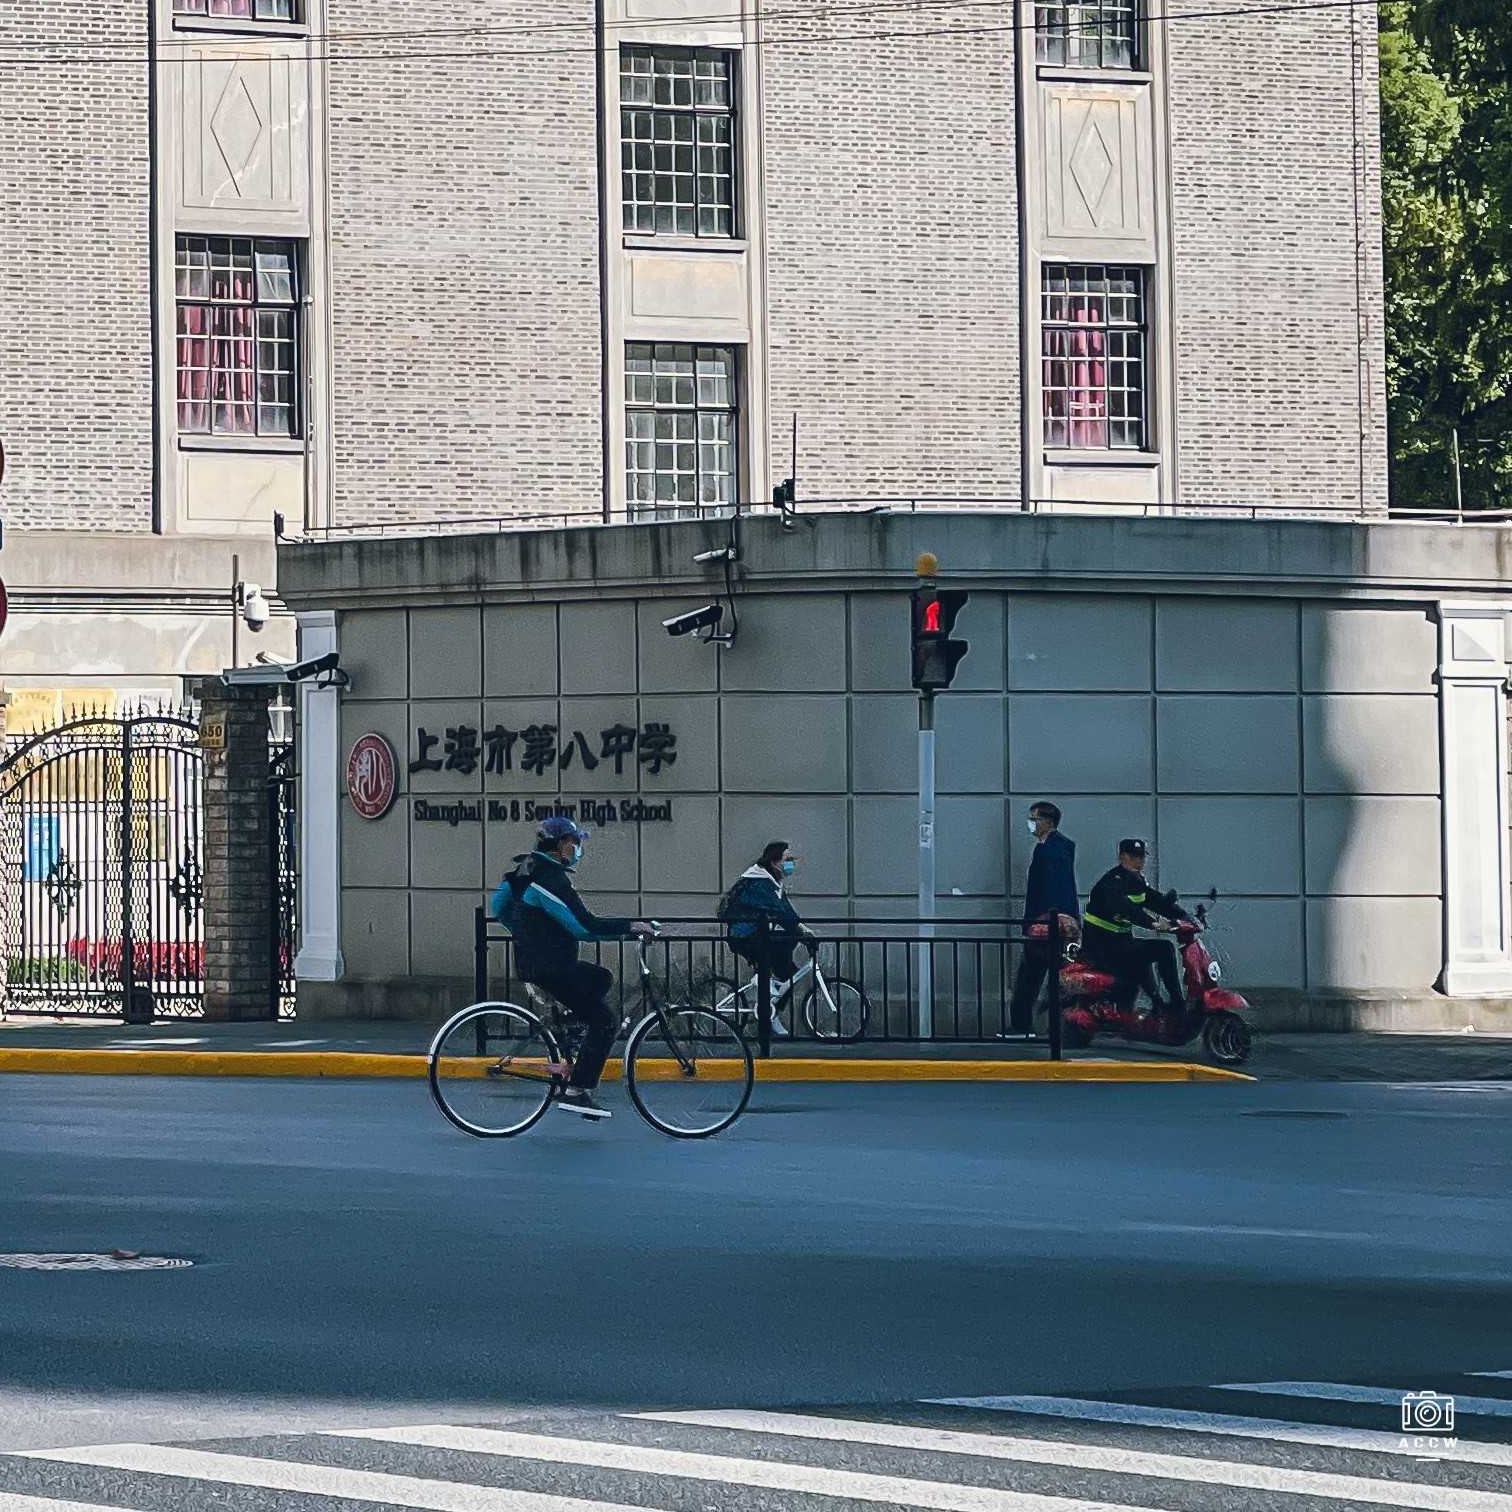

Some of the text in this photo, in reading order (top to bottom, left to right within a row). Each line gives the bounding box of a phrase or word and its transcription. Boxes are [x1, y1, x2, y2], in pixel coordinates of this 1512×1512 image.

[409, 722, 677, 776] 上海市第八中学
[413, 799, 482, 827] Shanghai
[510, 800, 520, 822] 8
[524, 799, 576, 822] Senior
[580, 799, 617, 827] High
[620, 798, 672, 823] School
